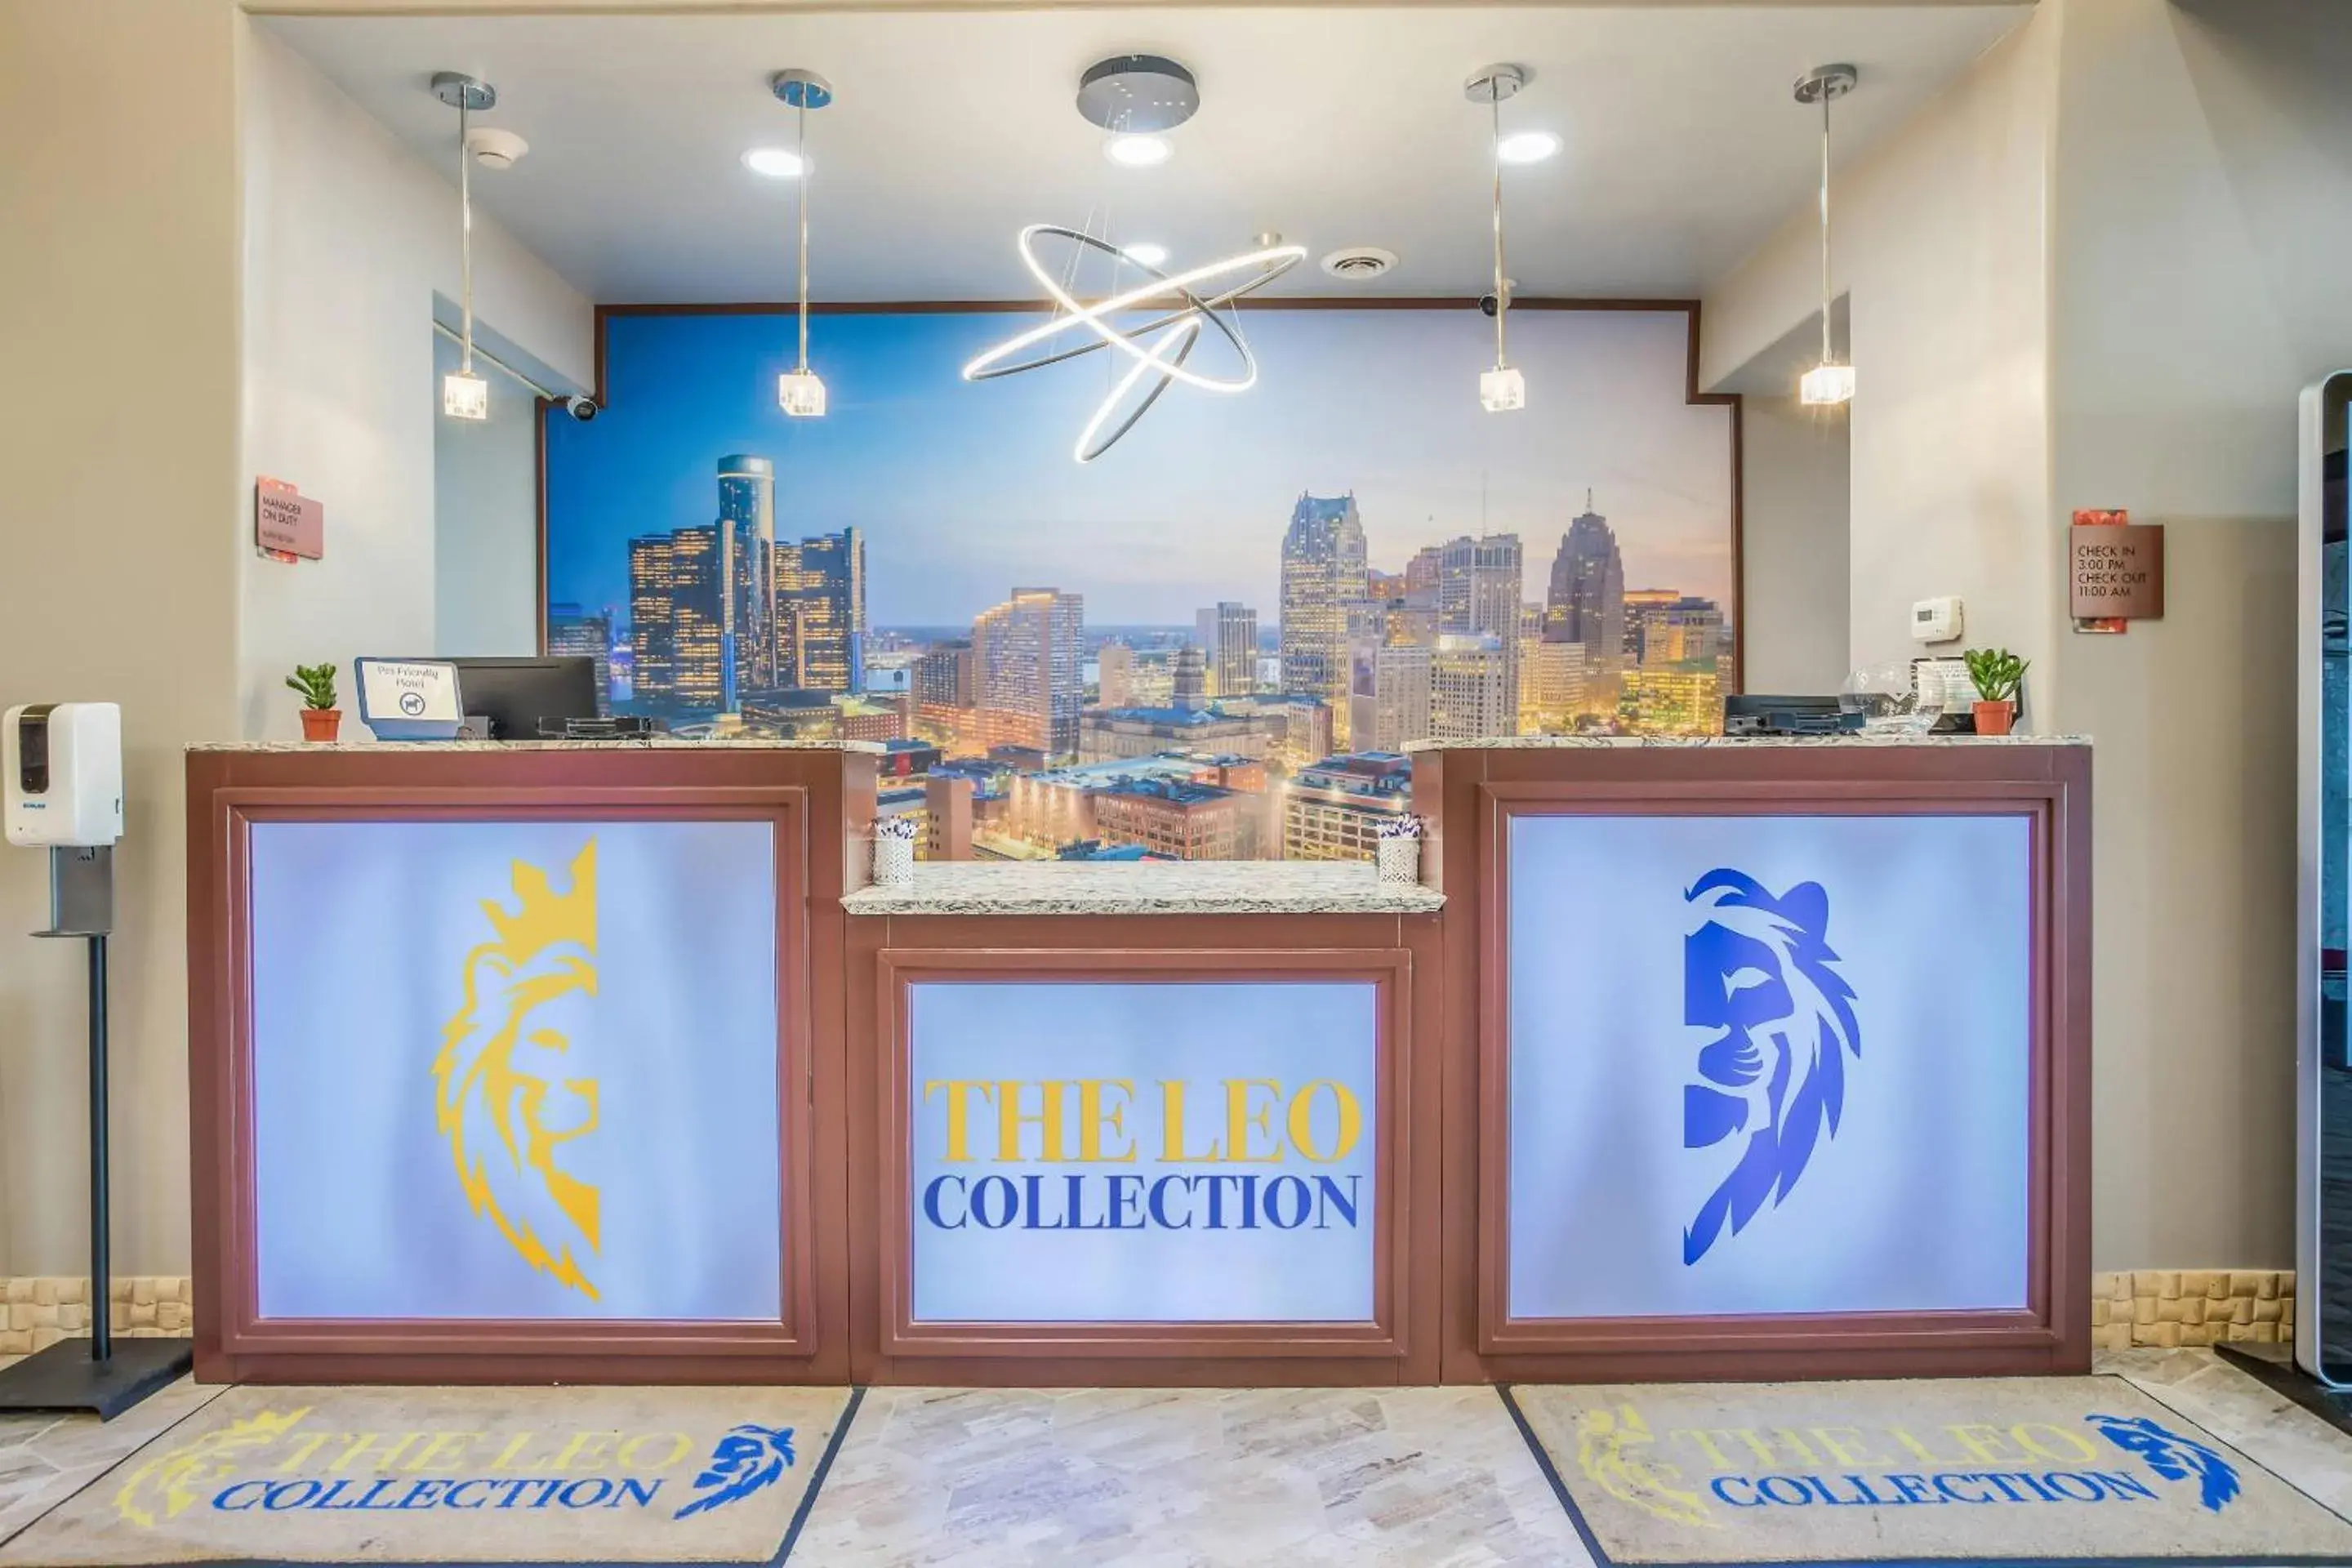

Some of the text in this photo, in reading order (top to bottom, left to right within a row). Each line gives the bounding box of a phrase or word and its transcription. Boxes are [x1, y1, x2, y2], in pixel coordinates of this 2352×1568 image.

[2078, 546, 2136, 557] CHECK IN
[2078, 559, 2125, 570] 3:00 PM
[2078, 573, 2147, 584] CHECK OUT
[2078, 586, 2132, 597] 11:00 AM
[924, 1078, 1362, 1164] THE LEO
[923, 1174, 1364, 1230] COLLECTION
[276, 1430, 694, 1472] THE LEO
[1668, 1423, 2098, 1468] THE LEO
[212, 1477, 670, 1510] COLLECTION
[1710, 1472, 2161, 1507] COLLECTION
